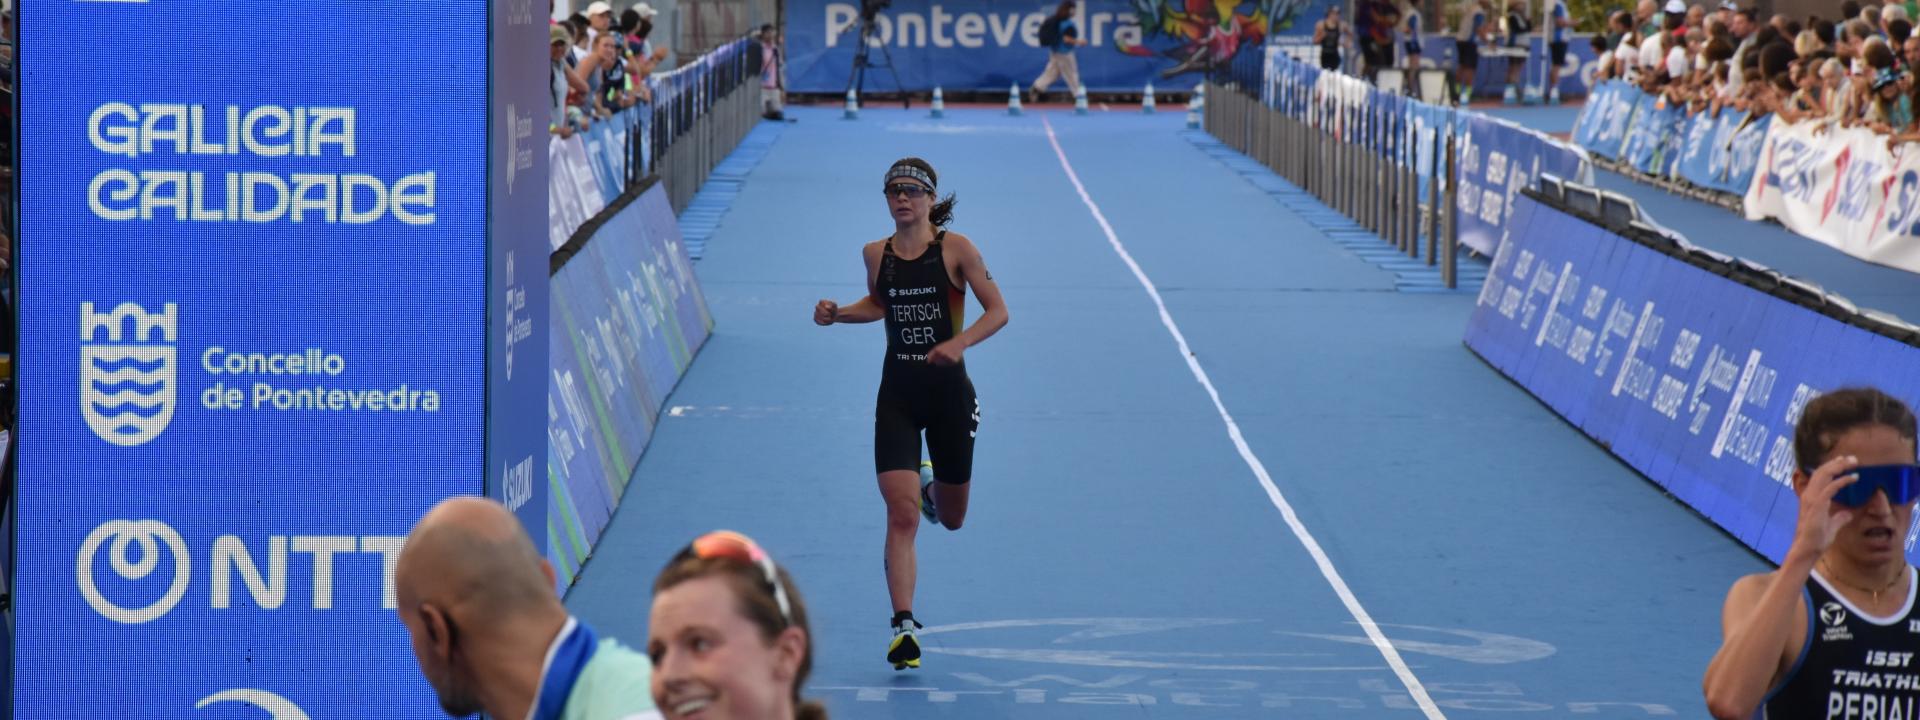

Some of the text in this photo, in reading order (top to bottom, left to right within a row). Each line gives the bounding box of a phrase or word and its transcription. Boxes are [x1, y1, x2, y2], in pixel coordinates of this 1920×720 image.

[88, 102, 356, 157] GALICIA
[88, 168, 437, 225] CALIDADE
[898, 286, 937, 296] SUZUKI
[892, 302, 942, 322] TERTSCH
[901, 326, 937, 345] GER
[201, 347, 346, 376] Concello
[202, 382, 441, 412] de Pontevedra
[508, 454, 533, 513] SUZUKI
[210, 534, 406, 609] NTT
[1865, 650, 1914, 667] ISSY
